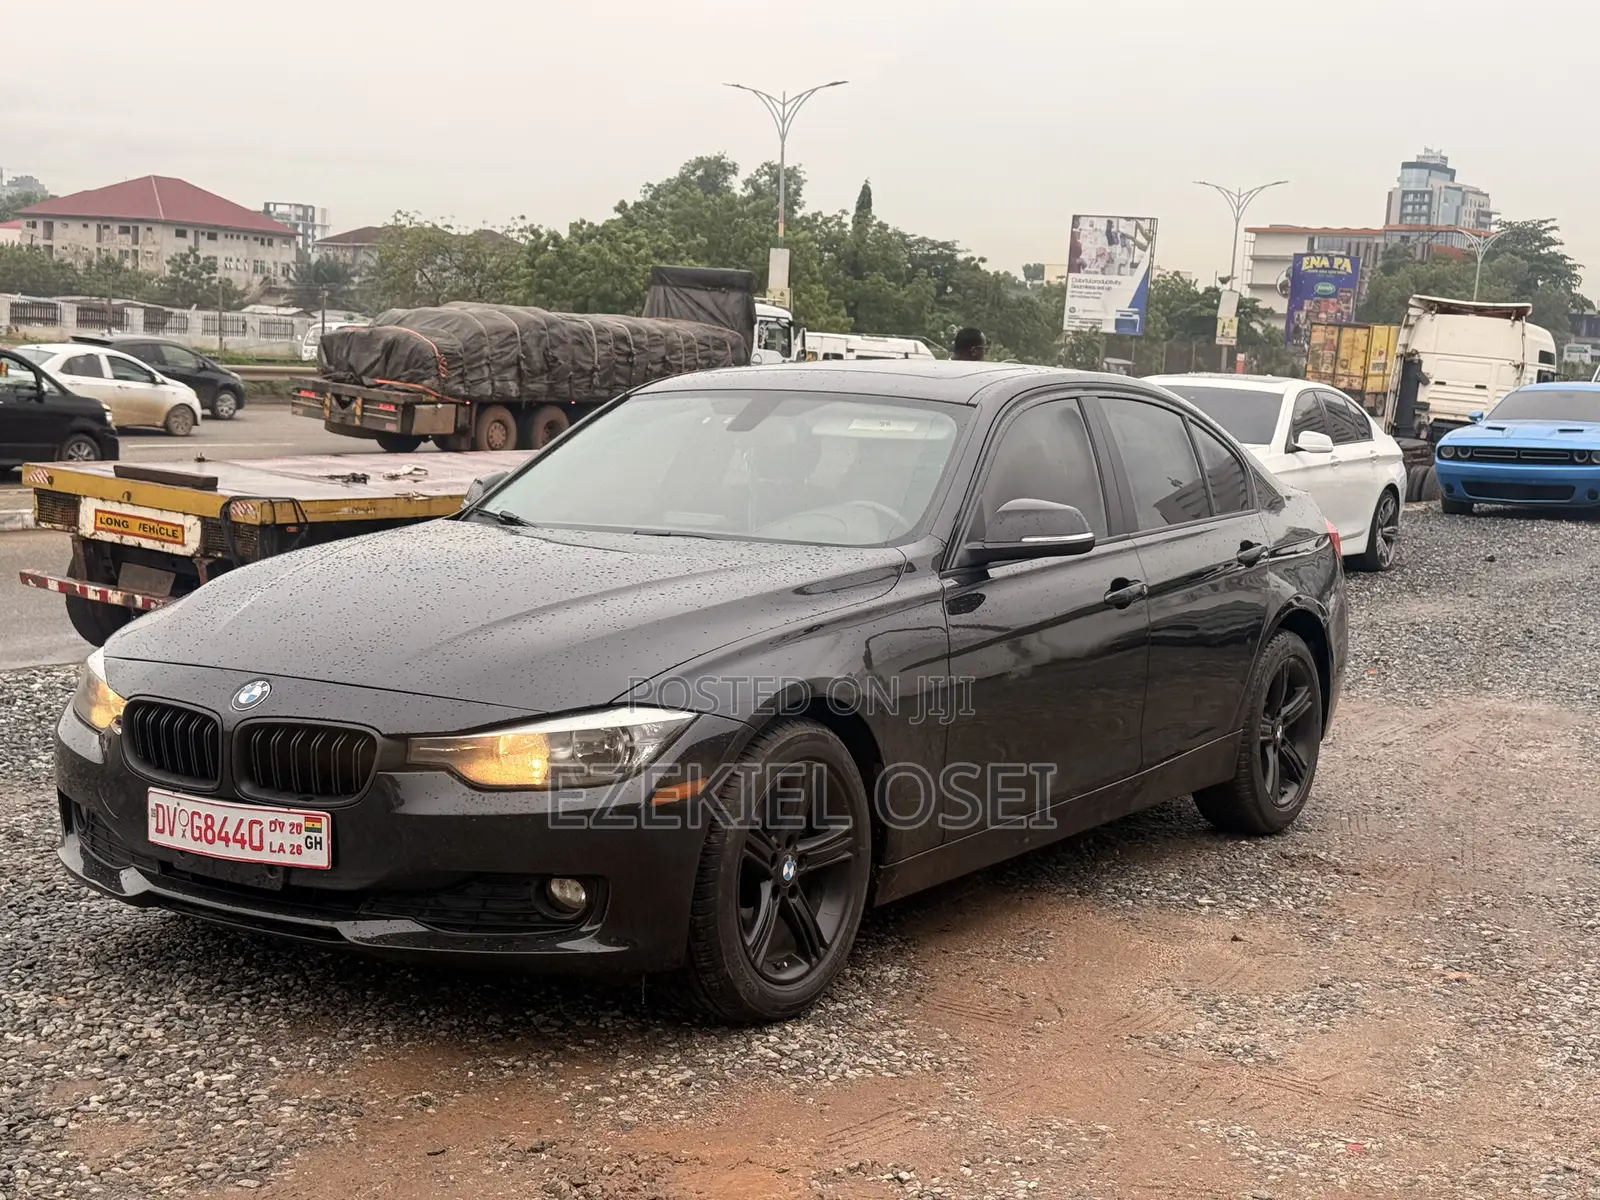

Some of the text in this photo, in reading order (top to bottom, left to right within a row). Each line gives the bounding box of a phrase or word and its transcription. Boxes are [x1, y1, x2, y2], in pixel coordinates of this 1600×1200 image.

[1301, 256, 1352, 274] ENA PA
[99, 516, 129, 529] LONG
[155, 802, 264, 851] DV G8440
[269, 820, 286, 833] DV
[269, 841, 302, 856] LA 26
[304, 835, 323, 851] GH
